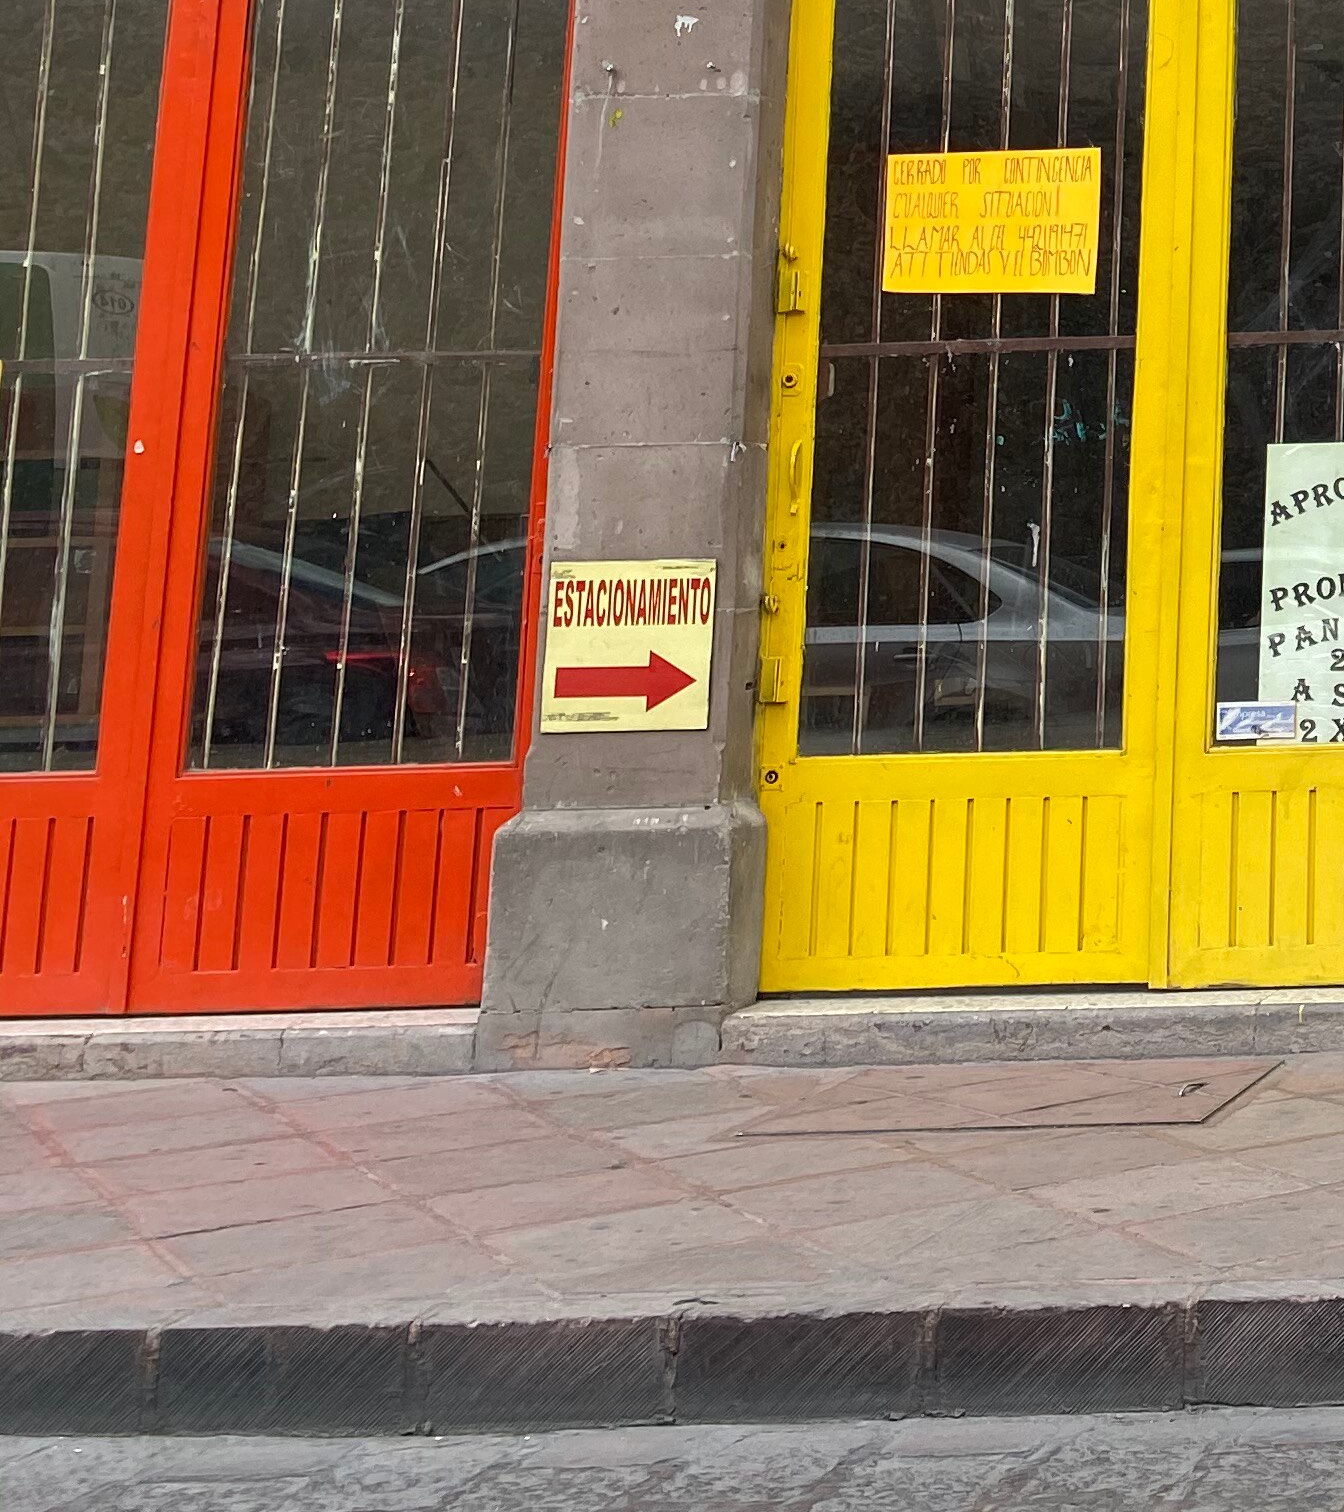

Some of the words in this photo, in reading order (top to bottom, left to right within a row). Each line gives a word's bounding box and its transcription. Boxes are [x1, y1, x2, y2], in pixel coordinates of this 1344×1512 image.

[893, 159, 947, 185] CERRADO
[962, 158, 982, 185] POR
[1003, 155, 1092, 184] CONTINGENCIA
[893, 191, 959, 219] CUALQUIER
[889, 224, 961, 250] LLAMAR
[1029, 249, 1092, 277] BOMBON
[553, 577, 711, 627] ESTACIONAMIENTO
[1290, 678, 1314, 702] A
[1299, 719, 1318, 743] 2
